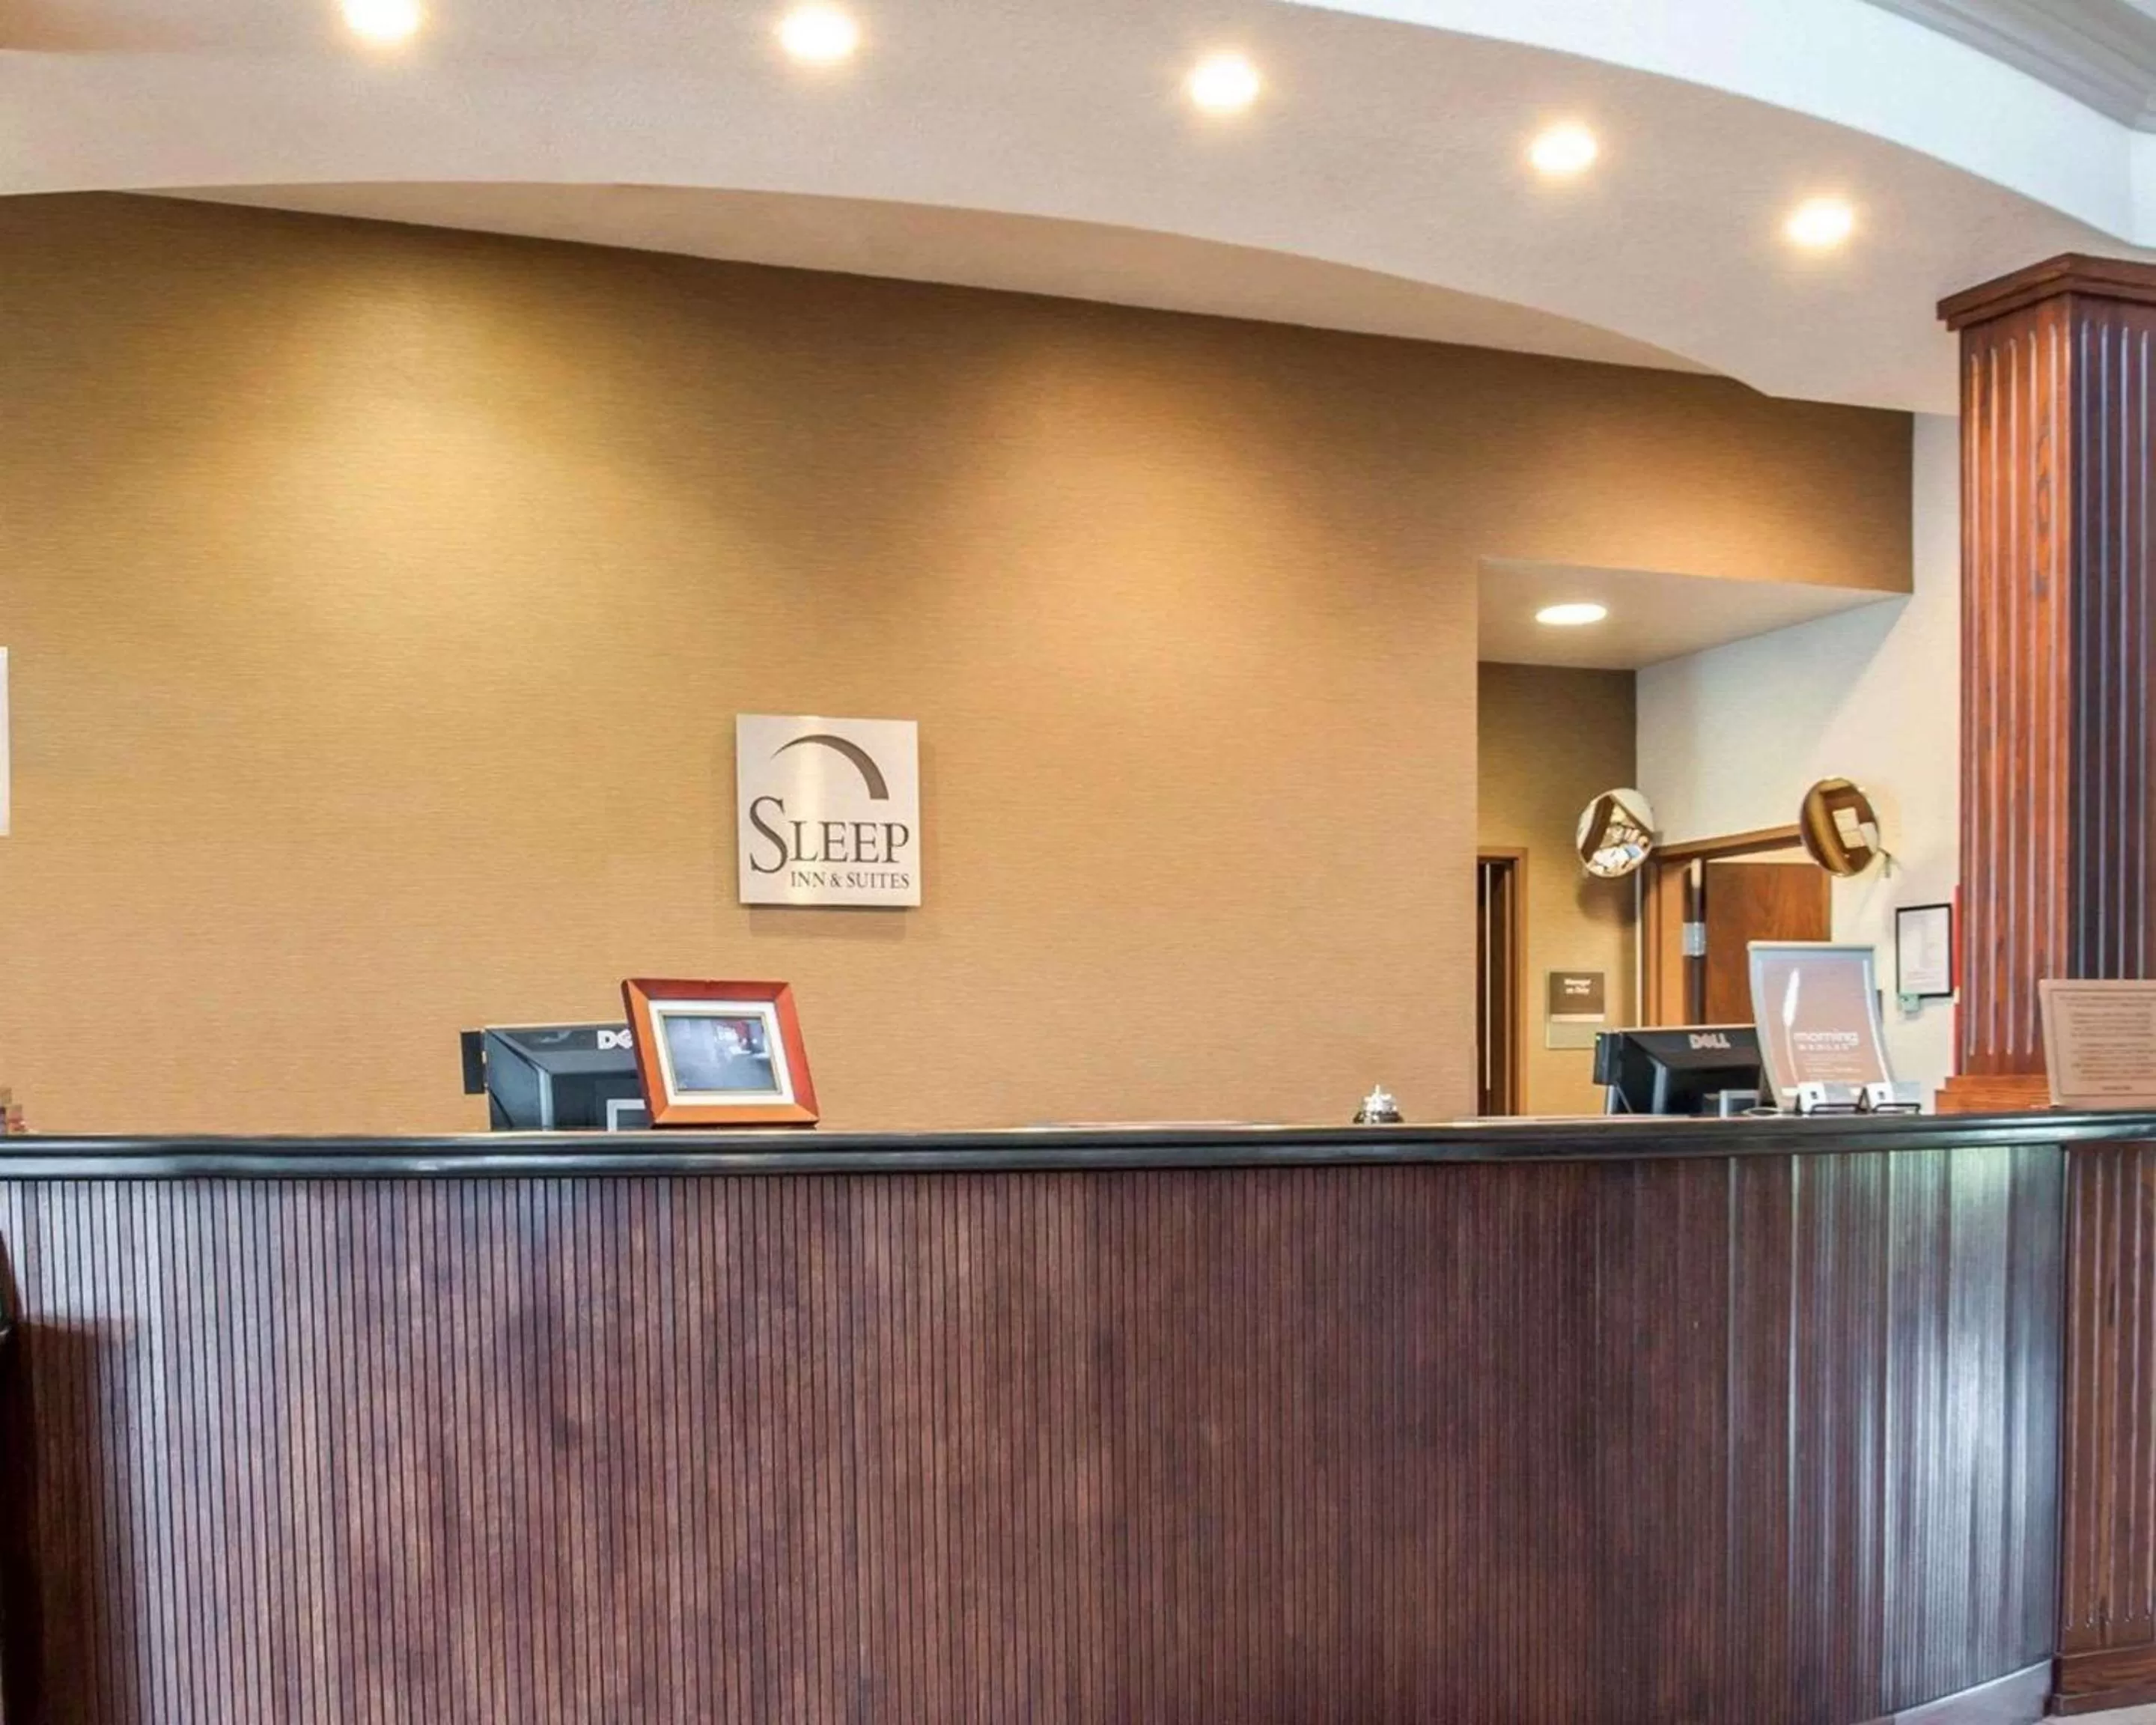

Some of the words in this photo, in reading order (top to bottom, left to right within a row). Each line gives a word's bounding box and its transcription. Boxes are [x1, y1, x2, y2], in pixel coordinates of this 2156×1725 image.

[749, 796, 910, 874] SLEEP
[791, 871, 827, 888] INN
[829, 873, 844, 888] &
[846, 871, 910, 889] SUITES
[597, 1029, 633, 1050] DE
[1688, 1032, 1732, 1049] DELL
